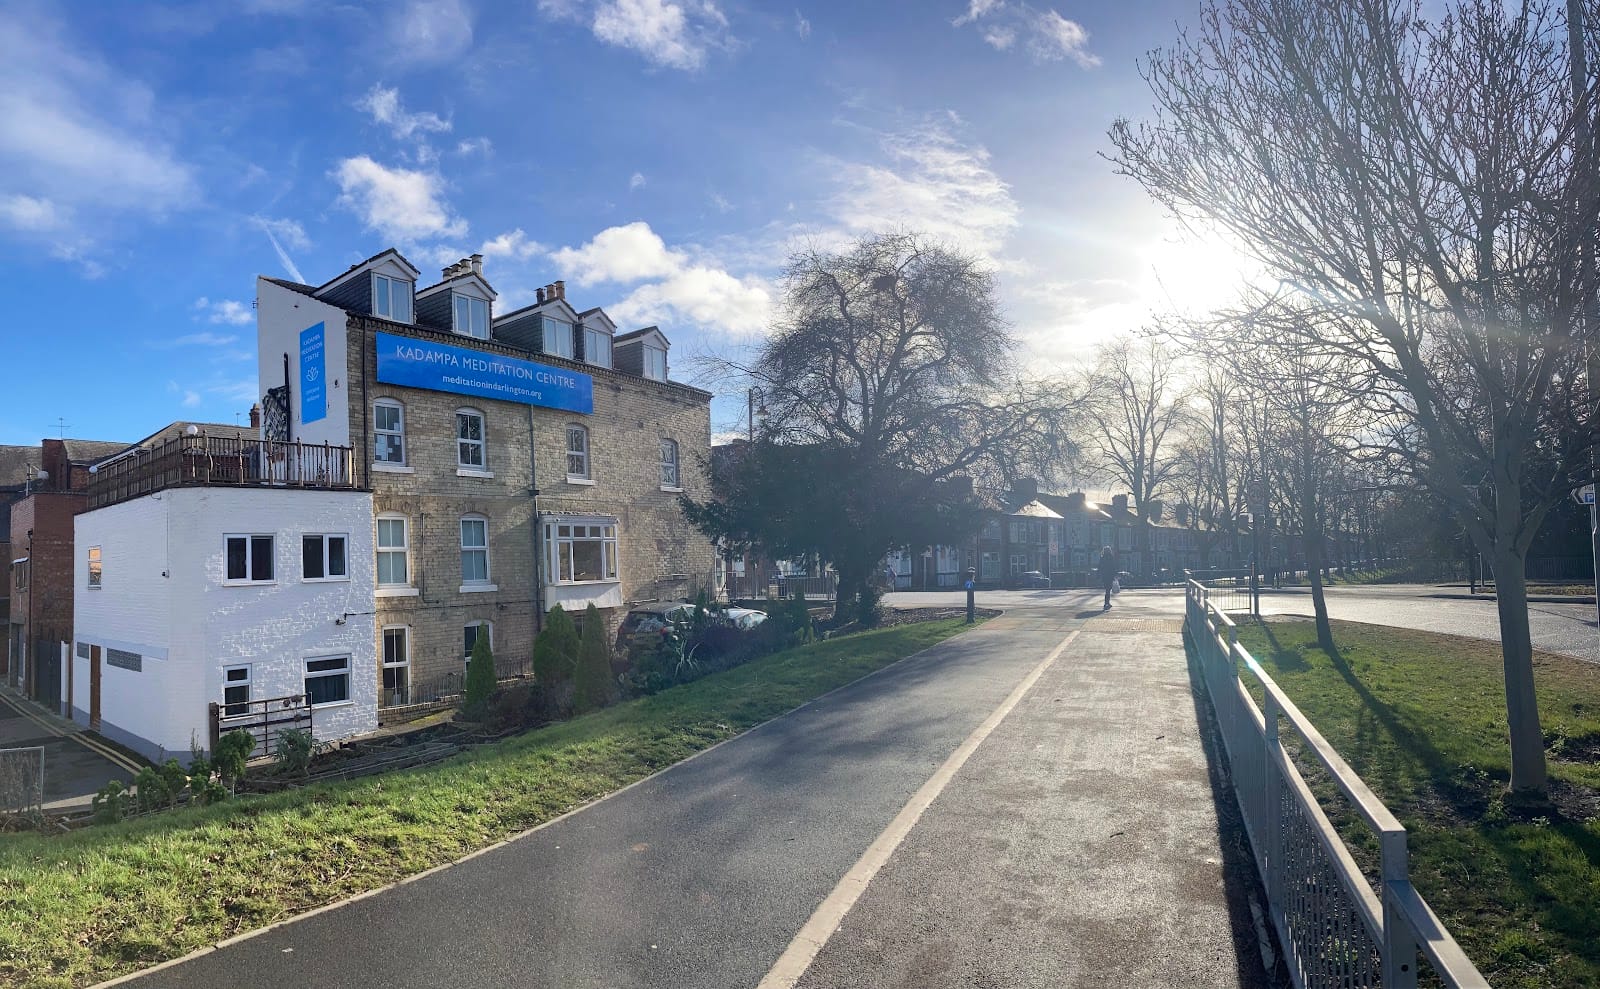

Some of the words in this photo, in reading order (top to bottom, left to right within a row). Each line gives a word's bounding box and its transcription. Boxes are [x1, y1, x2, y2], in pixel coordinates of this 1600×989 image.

[396, 345, 459, 367] KADAMPA
[463, 357, 533, 380] MEDITATION
[536, 372, 575, 389] CENTRE
[443, 376, 542, 400] meditationindarlington.org
